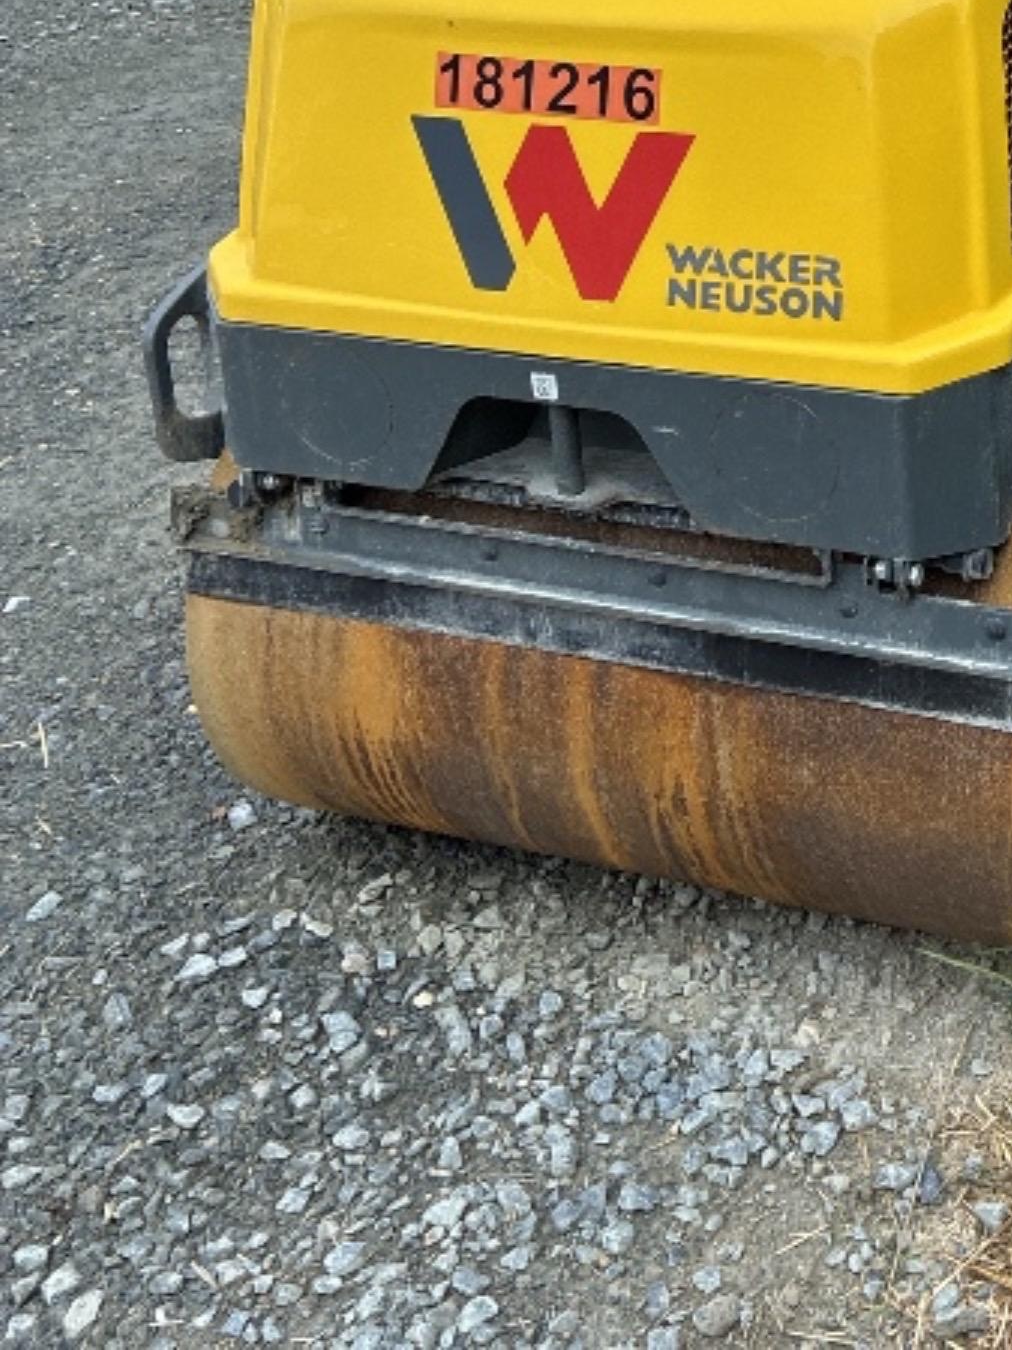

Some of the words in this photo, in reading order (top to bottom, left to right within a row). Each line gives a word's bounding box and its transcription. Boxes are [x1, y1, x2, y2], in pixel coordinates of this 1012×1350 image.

[440, 53, 655, 121] 181216
[665, 243, 842, 288] WACKER
[667, 278, 843, 321] NEUSON
